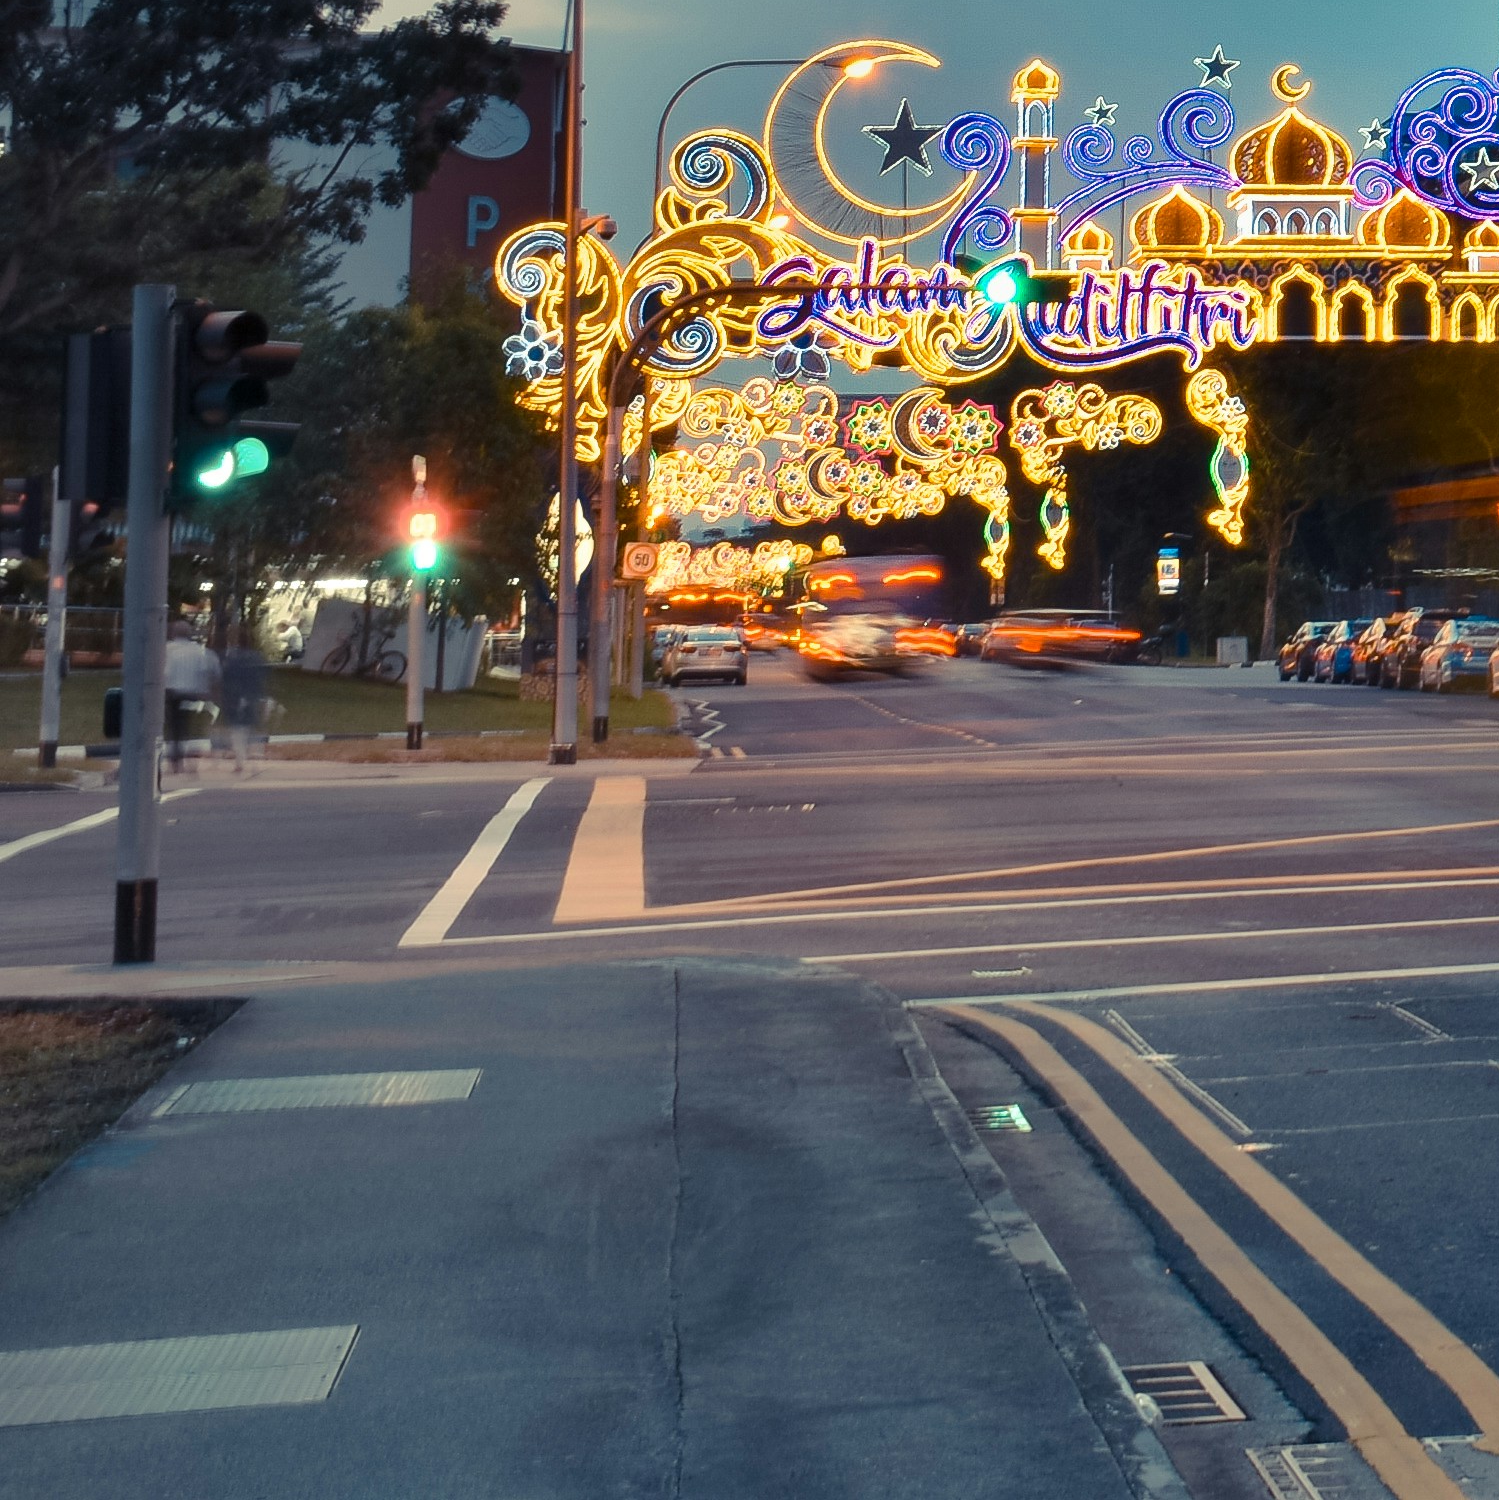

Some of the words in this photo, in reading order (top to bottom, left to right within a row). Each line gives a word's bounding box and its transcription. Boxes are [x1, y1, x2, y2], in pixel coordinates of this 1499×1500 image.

[467, 194, 500, 248] P
[756, 238, 969, 347] Salam
[634, 553, 650, 567] 50
